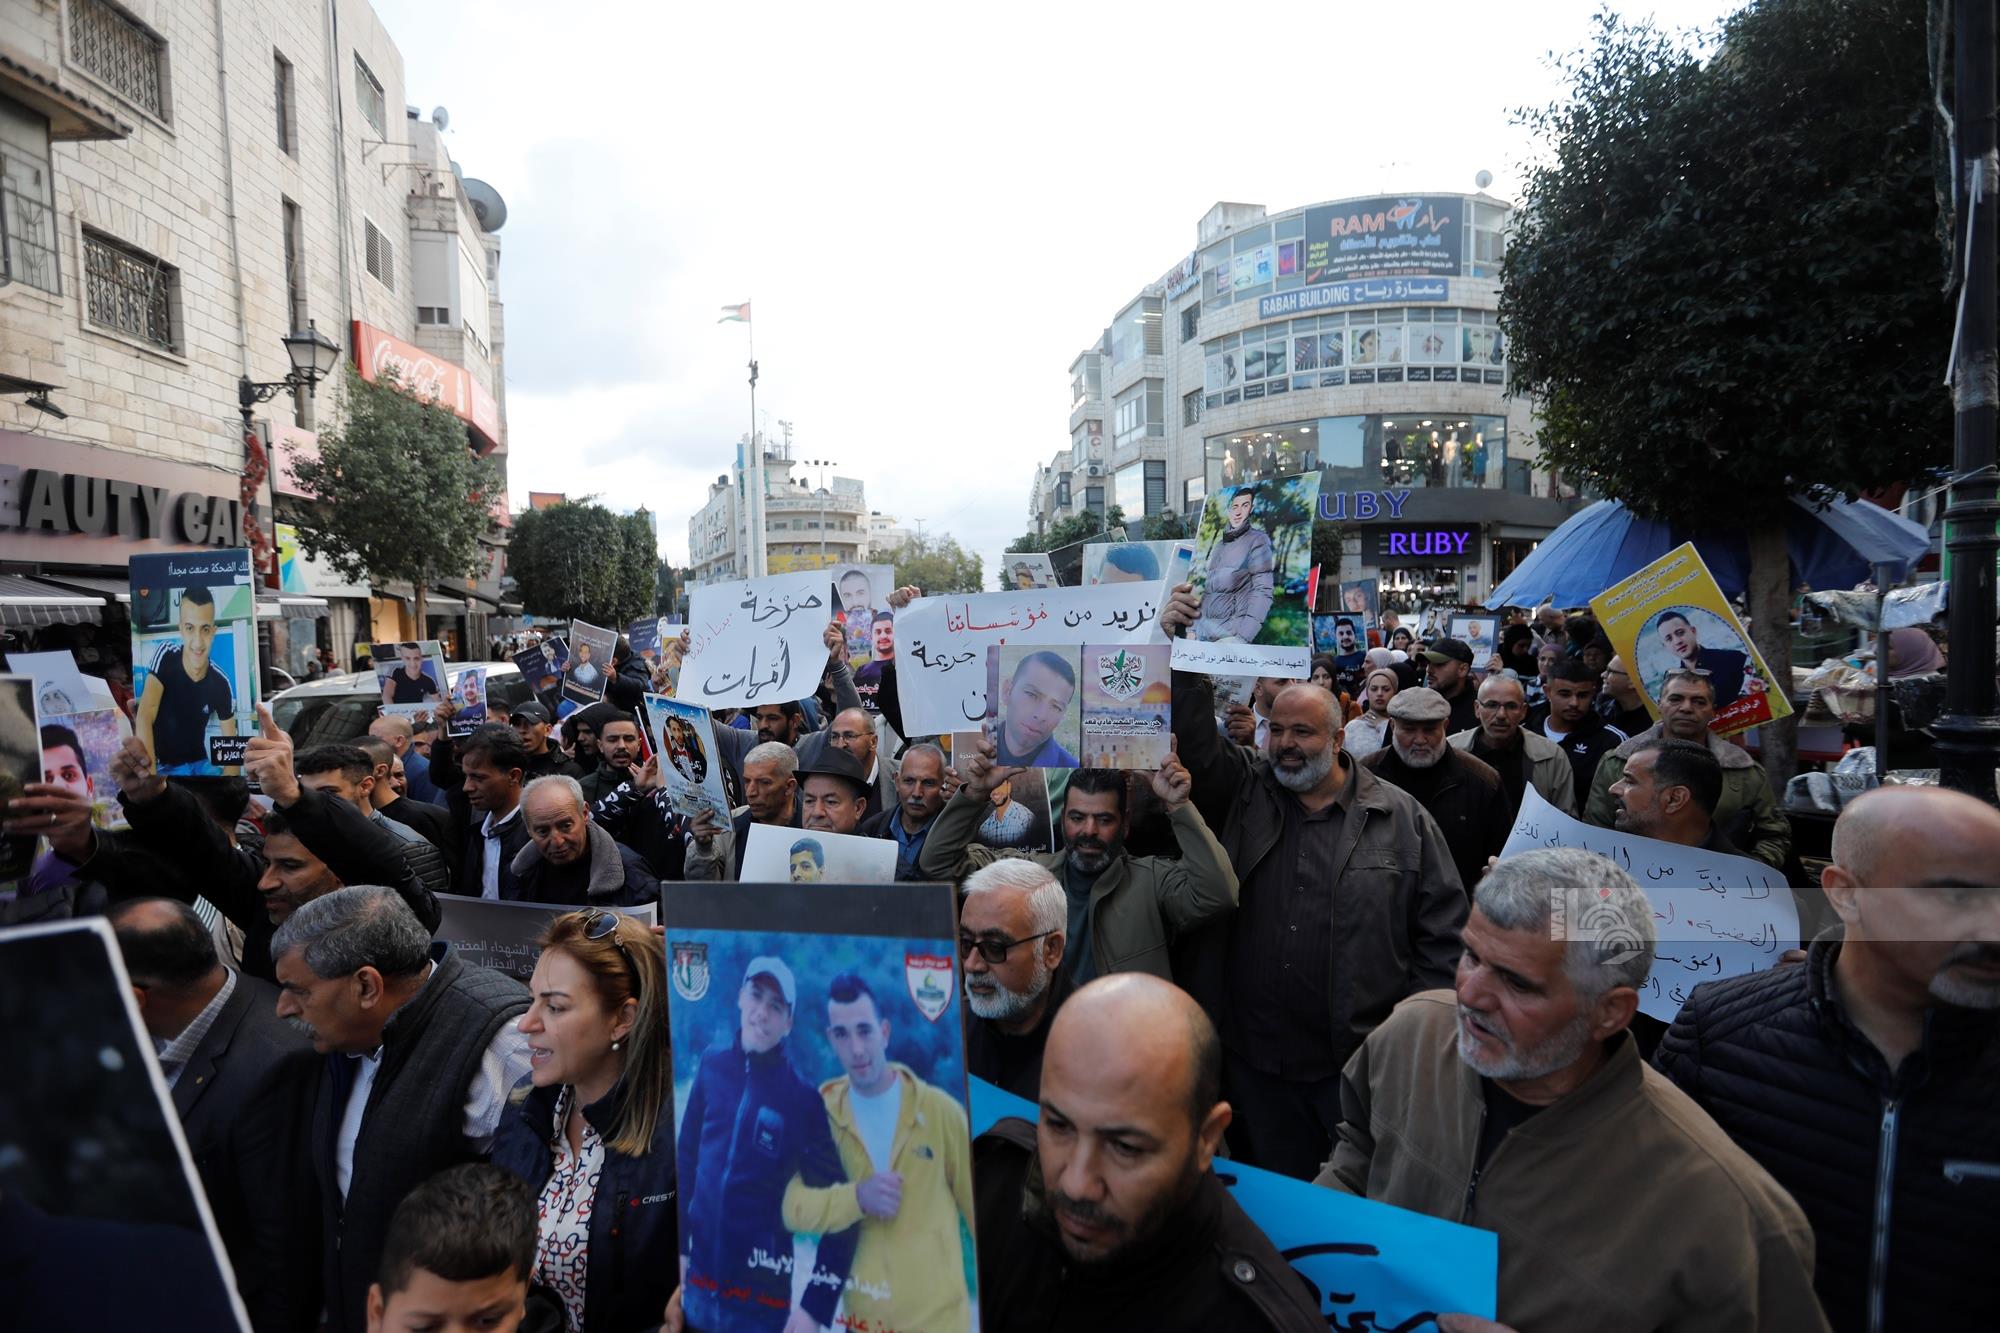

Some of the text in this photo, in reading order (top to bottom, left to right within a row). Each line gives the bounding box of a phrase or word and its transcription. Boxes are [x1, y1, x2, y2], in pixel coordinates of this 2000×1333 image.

[1330, 212, 1385, 238] RAM
[1262, 286, 1350, 316] RABAH BUILDING
[1353, 281, 1444, 302] عمارة رباح
[1318, 488, 1411, 521] UBY
[1389, 531, 1470, 556] RUBY
[1063, 609, 1092, 627] من
[1646, 863, 1674, 880] من
[490, 941, 529, 959] الشهداء
